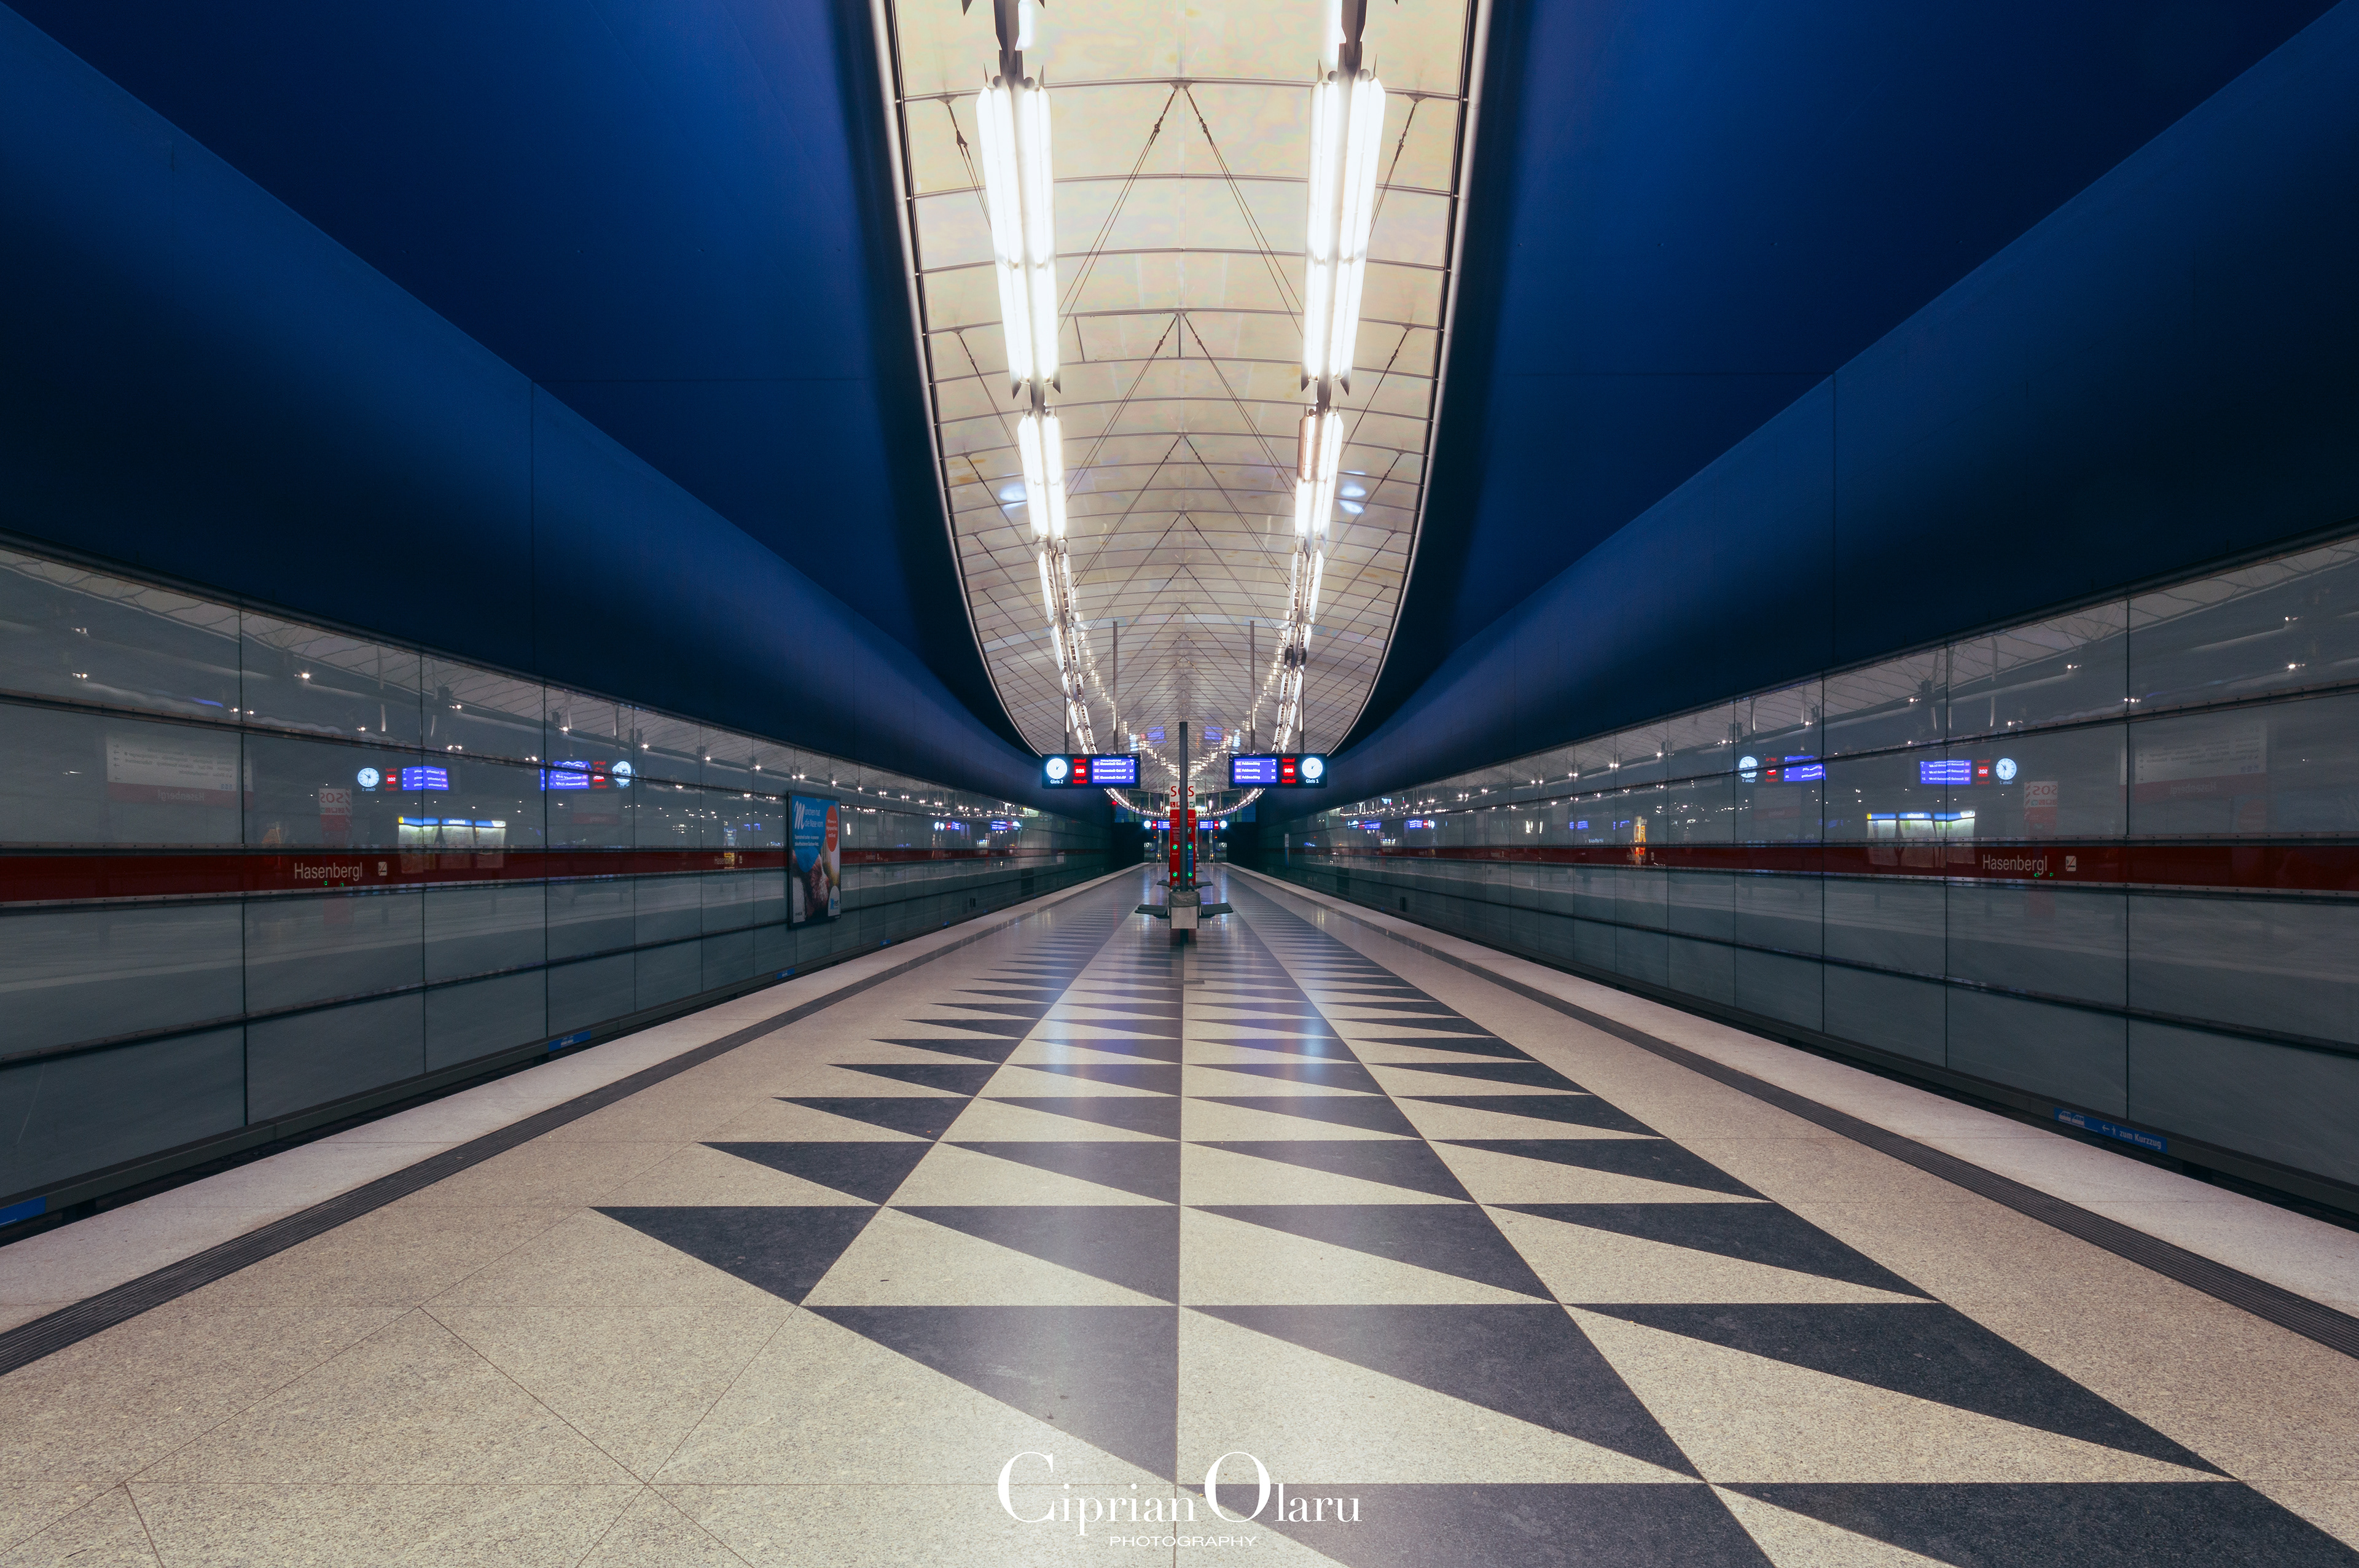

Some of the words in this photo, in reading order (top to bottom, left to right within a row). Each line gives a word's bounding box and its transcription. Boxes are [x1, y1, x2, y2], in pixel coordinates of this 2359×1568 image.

[1170, 786, 1194, 797] SS
[294, 862, 363, 881] Hasenbergl
[1982, 854, 2048, 876] Hasenbergl
[2119, 1130, 2134, 1140] zum
[2135, 1133, 2162, 1149] Kurzzug
